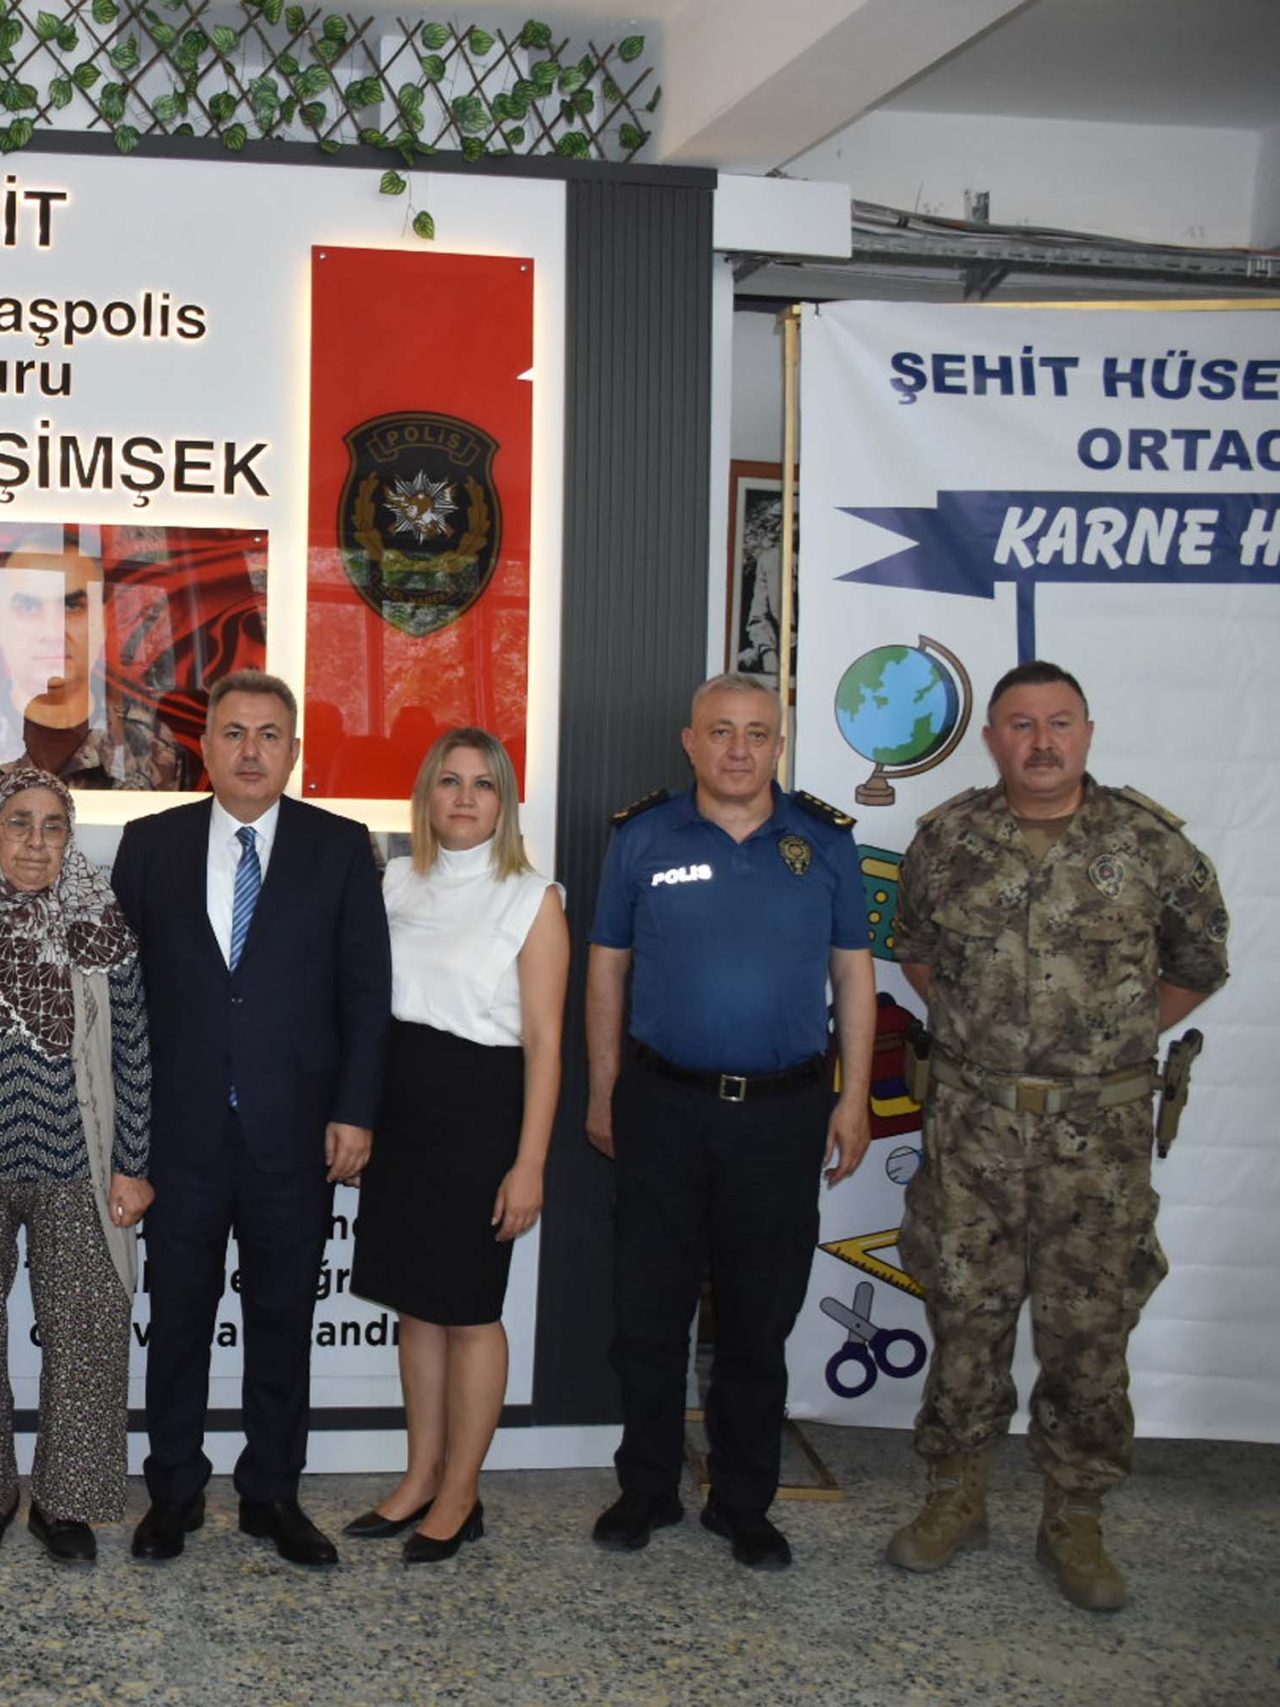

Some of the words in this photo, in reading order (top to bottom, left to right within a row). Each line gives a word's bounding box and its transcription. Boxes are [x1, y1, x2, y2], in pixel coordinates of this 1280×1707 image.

[890, 345, 1079, 404] ŞEHİT
[1103, 350, 1280, 400] HÜSE
[993, 507, 1219, 570] KARNE
[1240, 508, 1280, 567] H
